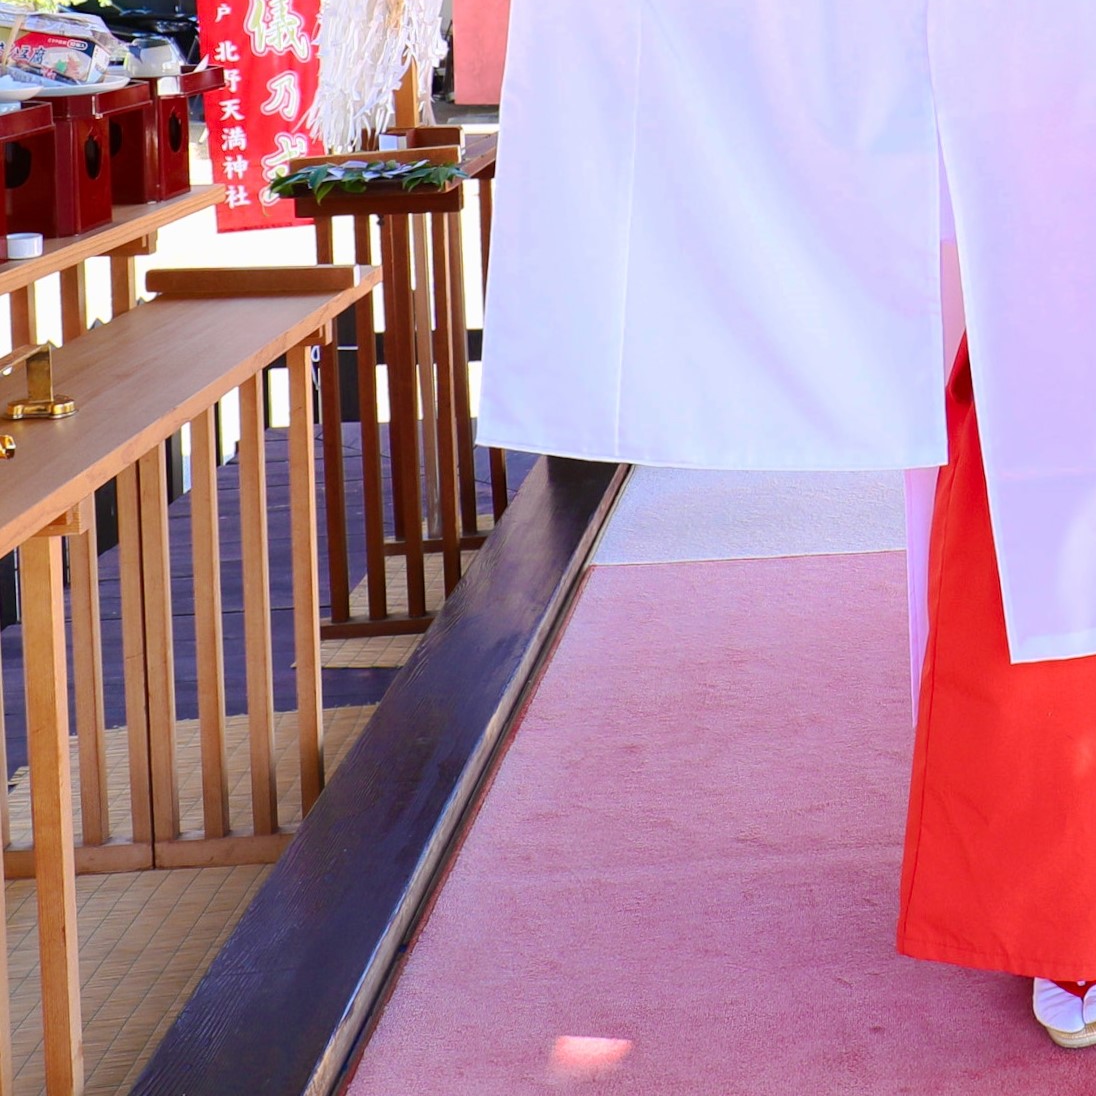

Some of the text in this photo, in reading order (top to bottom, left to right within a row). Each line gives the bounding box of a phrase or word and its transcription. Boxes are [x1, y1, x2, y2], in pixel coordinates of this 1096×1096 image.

[213, 40, 251, 209] 北野天満神社
